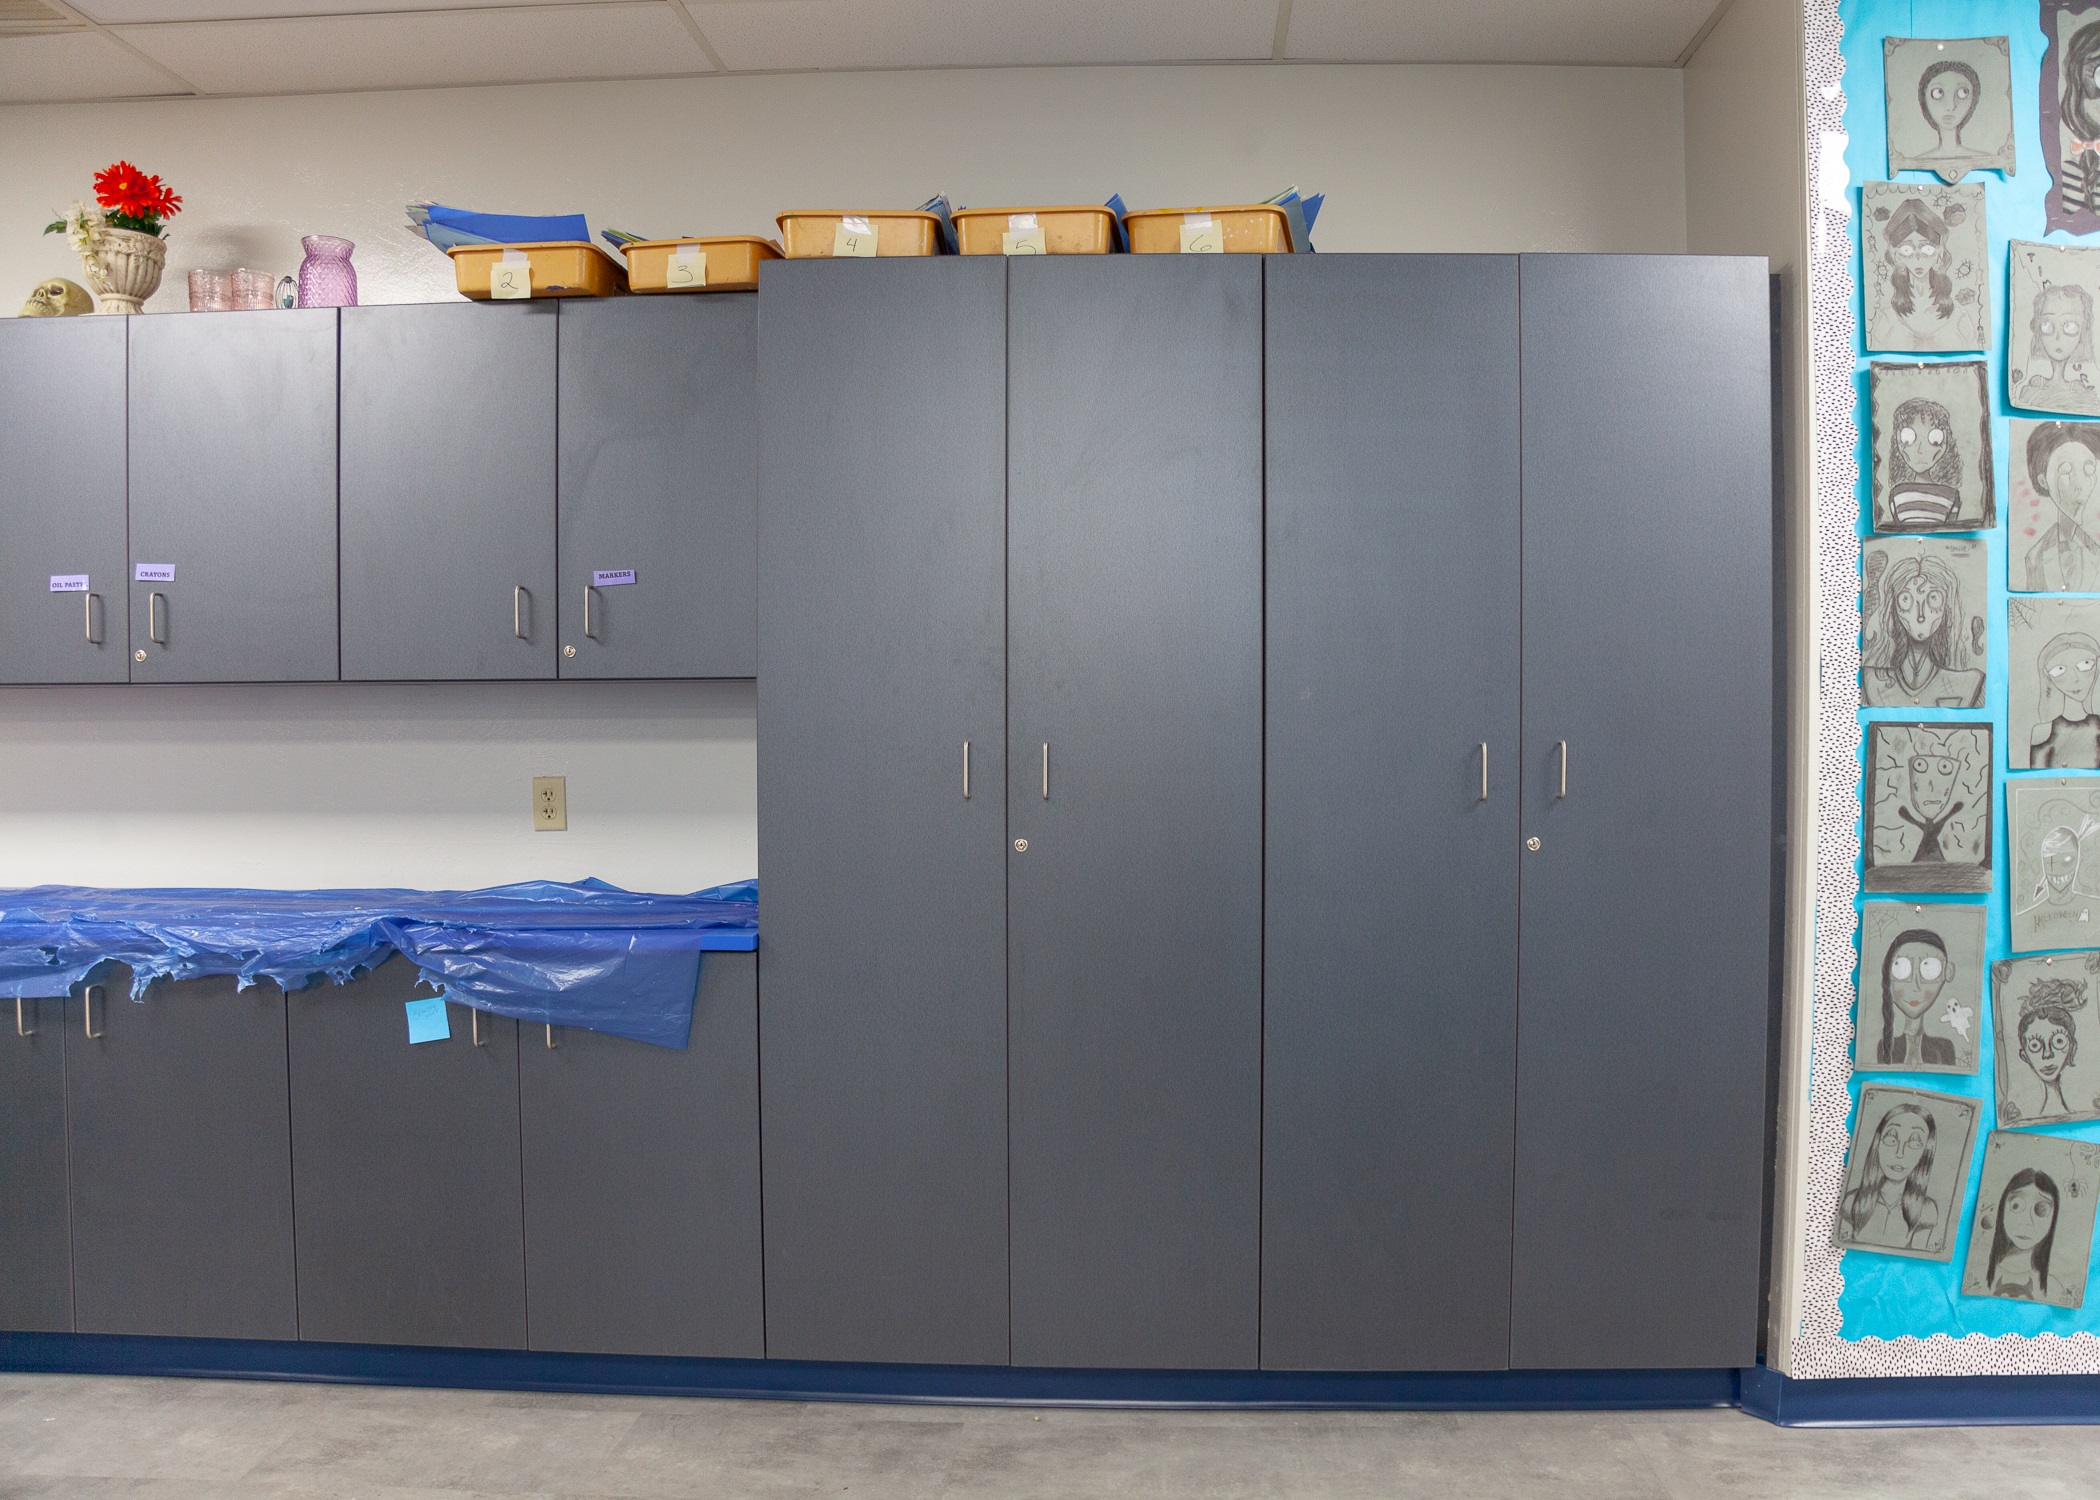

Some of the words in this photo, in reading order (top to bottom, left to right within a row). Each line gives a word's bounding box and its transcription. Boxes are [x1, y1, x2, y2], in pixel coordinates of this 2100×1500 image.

[846, 238, 858, 252] 4
[1015, 239, 1037, 255] 5
[1189, 234, 1213, 252] 6
[500, 272, 519, 290] 2
[671, 265, 694, 284] 3
[598, 570, 632, 580] MARKERS
